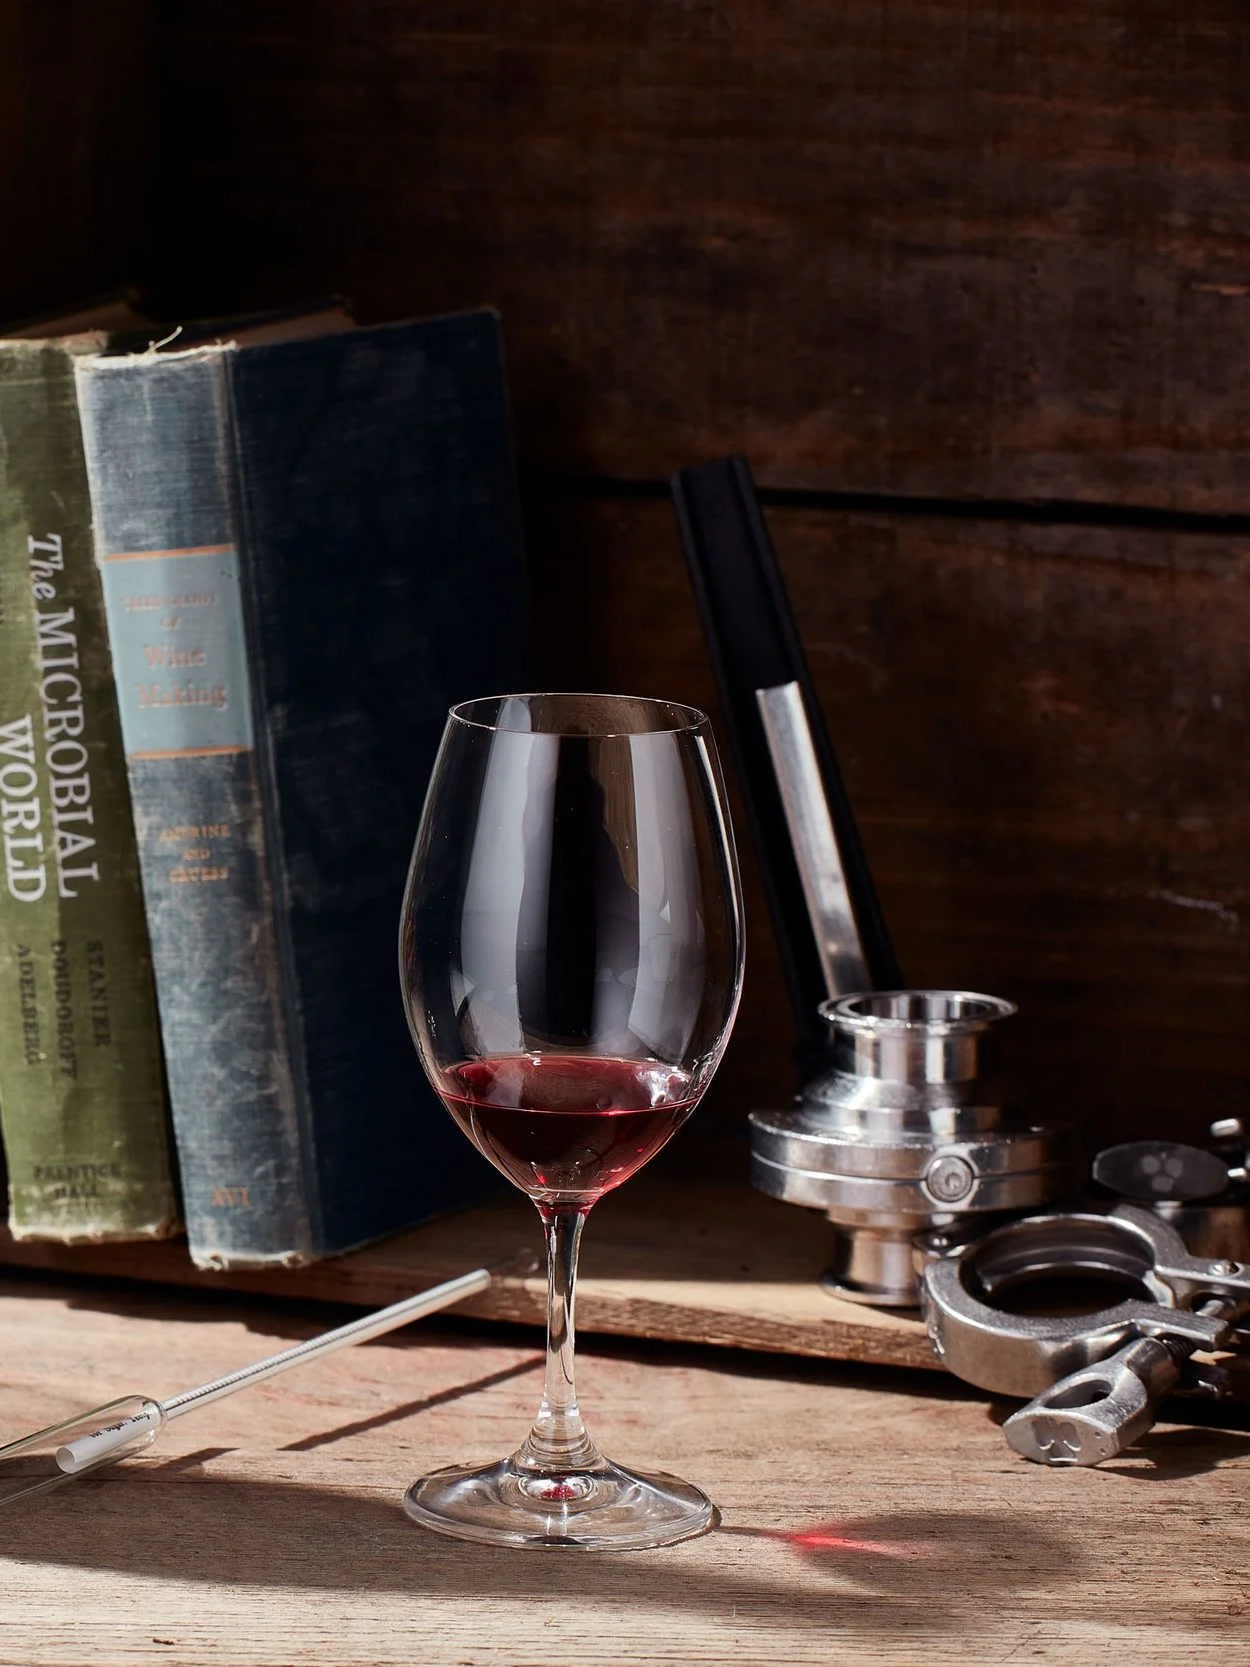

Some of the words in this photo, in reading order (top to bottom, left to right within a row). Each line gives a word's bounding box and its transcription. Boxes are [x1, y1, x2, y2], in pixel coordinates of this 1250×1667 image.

[27, 533, 62, 601] The
[144, 643, 206, 668] Wine
[35, 607, 99, 898] MICROBIAL
[86, 940, 111, 1047] STANIER
